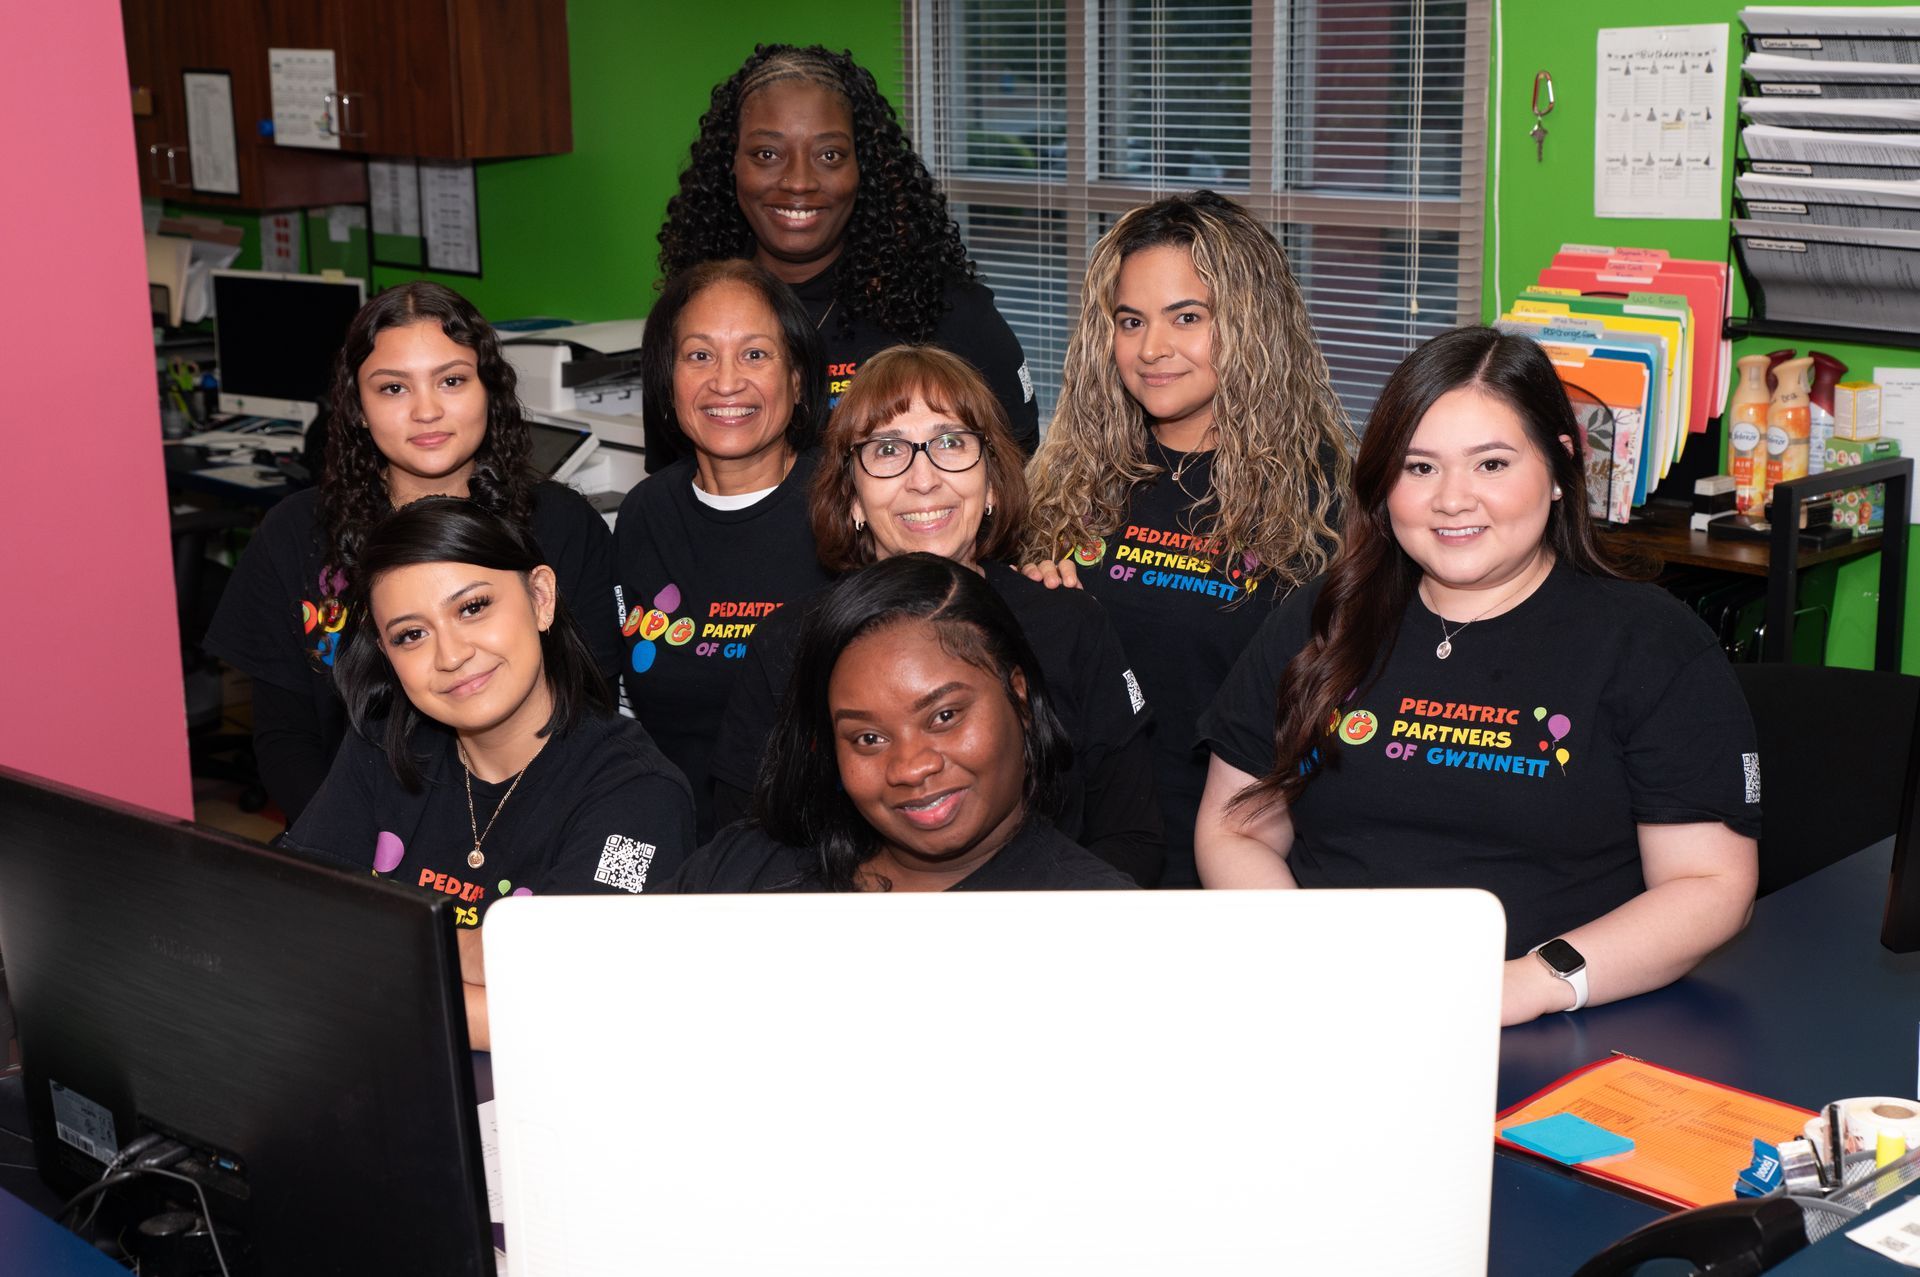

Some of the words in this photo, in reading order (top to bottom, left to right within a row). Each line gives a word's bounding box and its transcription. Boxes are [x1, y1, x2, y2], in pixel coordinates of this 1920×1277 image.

[1115, 545, 1212, 573] PARTNERS
[1109, 564, 1137, 582] OF
[1141, 570, 1239, 602] GWINNETT
[695, 641, 720, 657] OF
[1399, 697, 1521, 725] PEDIATRIC
[1391, 720, 1513, 749] PARTNERS
[1385, 741, 1418, 761] OF
[1426, 747, 1550, 778] GWINNETT
